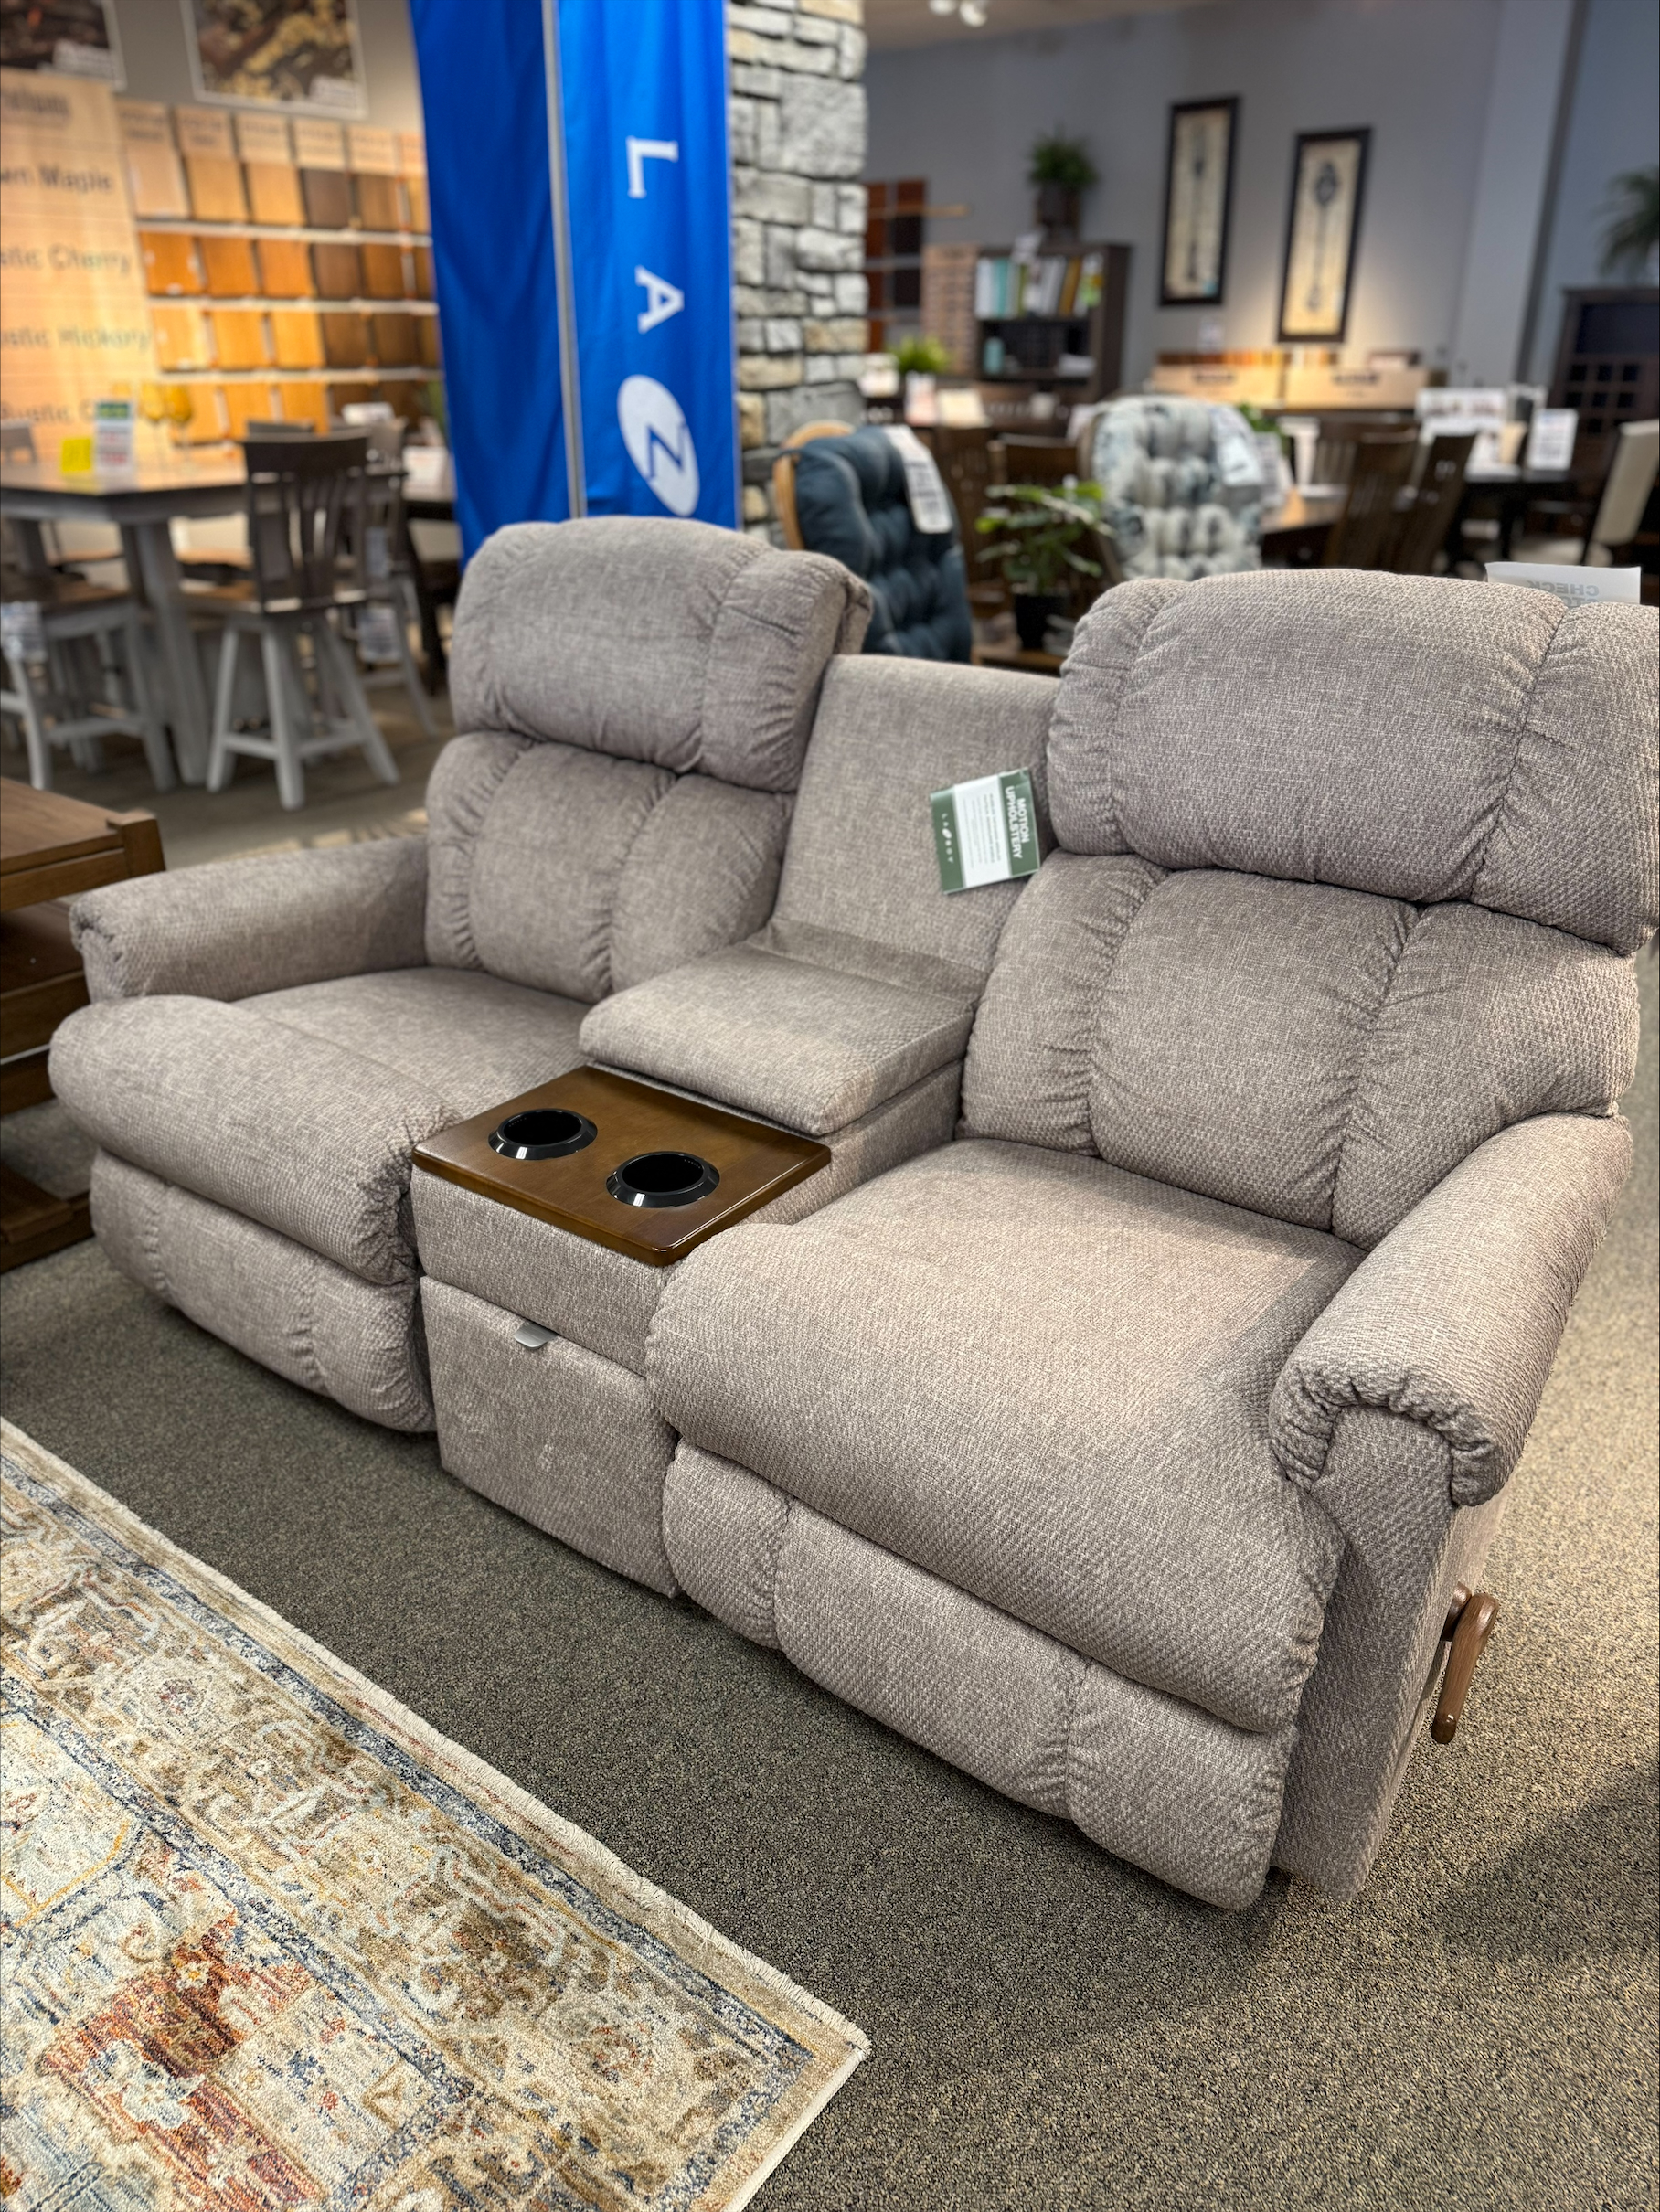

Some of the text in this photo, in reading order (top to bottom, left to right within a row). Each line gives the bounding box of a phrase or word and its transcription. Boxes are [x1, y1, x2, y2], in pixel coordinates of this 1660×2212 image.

[38, 163, 112, 194] Maple
[48, 243, 130, 276] Cherry
[57, 326, 150, 351] Hickory
[1006, 786, 1023, 859] UPHOLSTERY
[1017, 797, 1030, 843] MOTION
